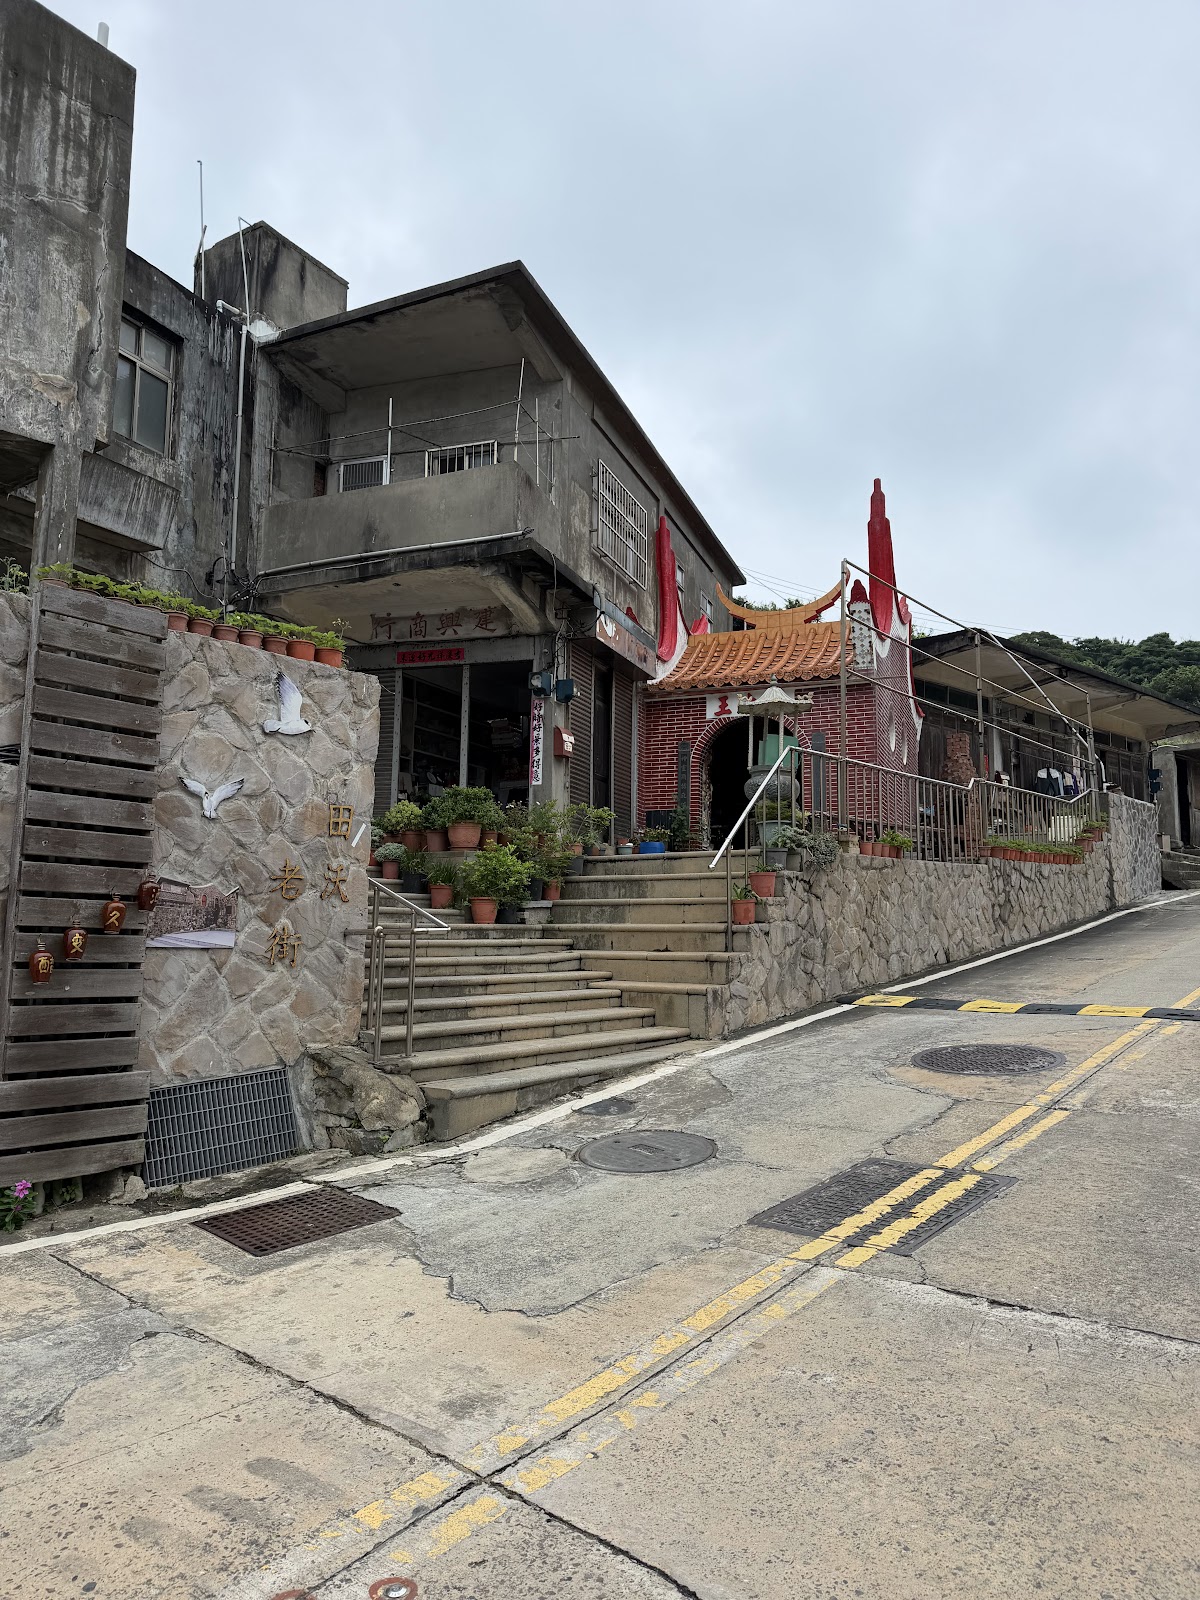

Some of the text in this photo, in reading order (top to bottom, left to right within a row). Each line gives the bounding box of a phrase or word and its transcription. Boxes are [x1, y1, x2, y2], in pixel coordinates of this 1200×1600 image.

[371, 607, 497, 640] 建興商行
[320, 804, 354, 903] 田沃
[265, 857, 305, 968] 老街
